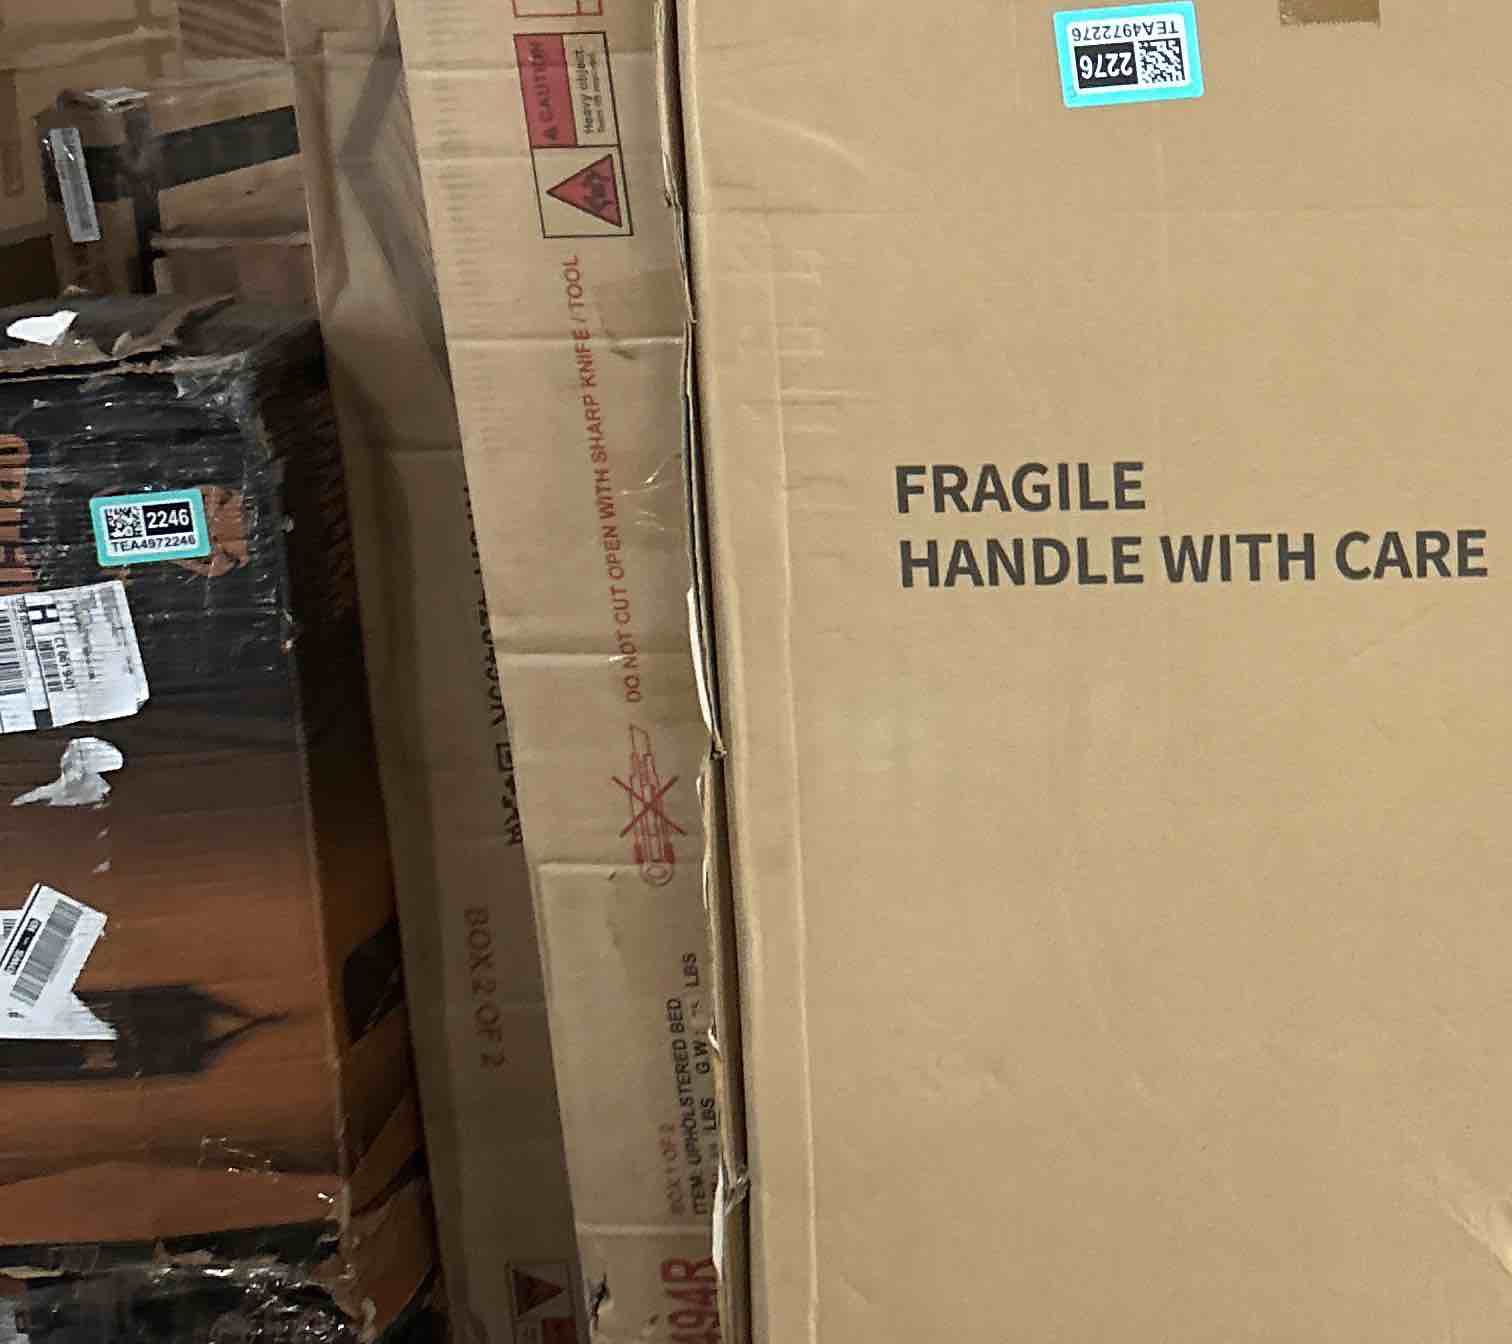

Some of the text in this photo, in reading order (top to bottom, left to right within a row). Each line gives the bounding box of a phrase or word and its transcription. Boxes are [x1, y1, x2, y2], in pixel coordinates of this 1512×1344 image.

[1071, 20, 1180, 42] TEA4972276
[1079, 52, 1134, 80] 2276
[562, 256, 585, 314] TOOL
[574, 329, 597, 387] KNIFE
[584, 394, 608, 464] SHARP
[594, 469, 617, 520] WITH
[895, 461, 1147, 514] FRAGILE
[146, 508, 190, 529] 2246
[110, 535, 197, 553] TEA4972246
[602, 525, 625, 581] OPEN
[899, 529, 1489, 589] HANDLE WITH CARE
[609, 585, 632, 625] CUT
[617, 630, 640, 669] NOT
[624, 674, 643, 704] DO
[464, 907, 494, 972] BOX
[472, 977, 497, 994] 2
[682, 952, 699, 988] LBS
[475, 1004, 503, 1042] OF
[666, 998, 685, 1034] BED
[671, 1038, 702, 1167] UPHOLSTERED
[701, 1096, 718, 1132] LBS
